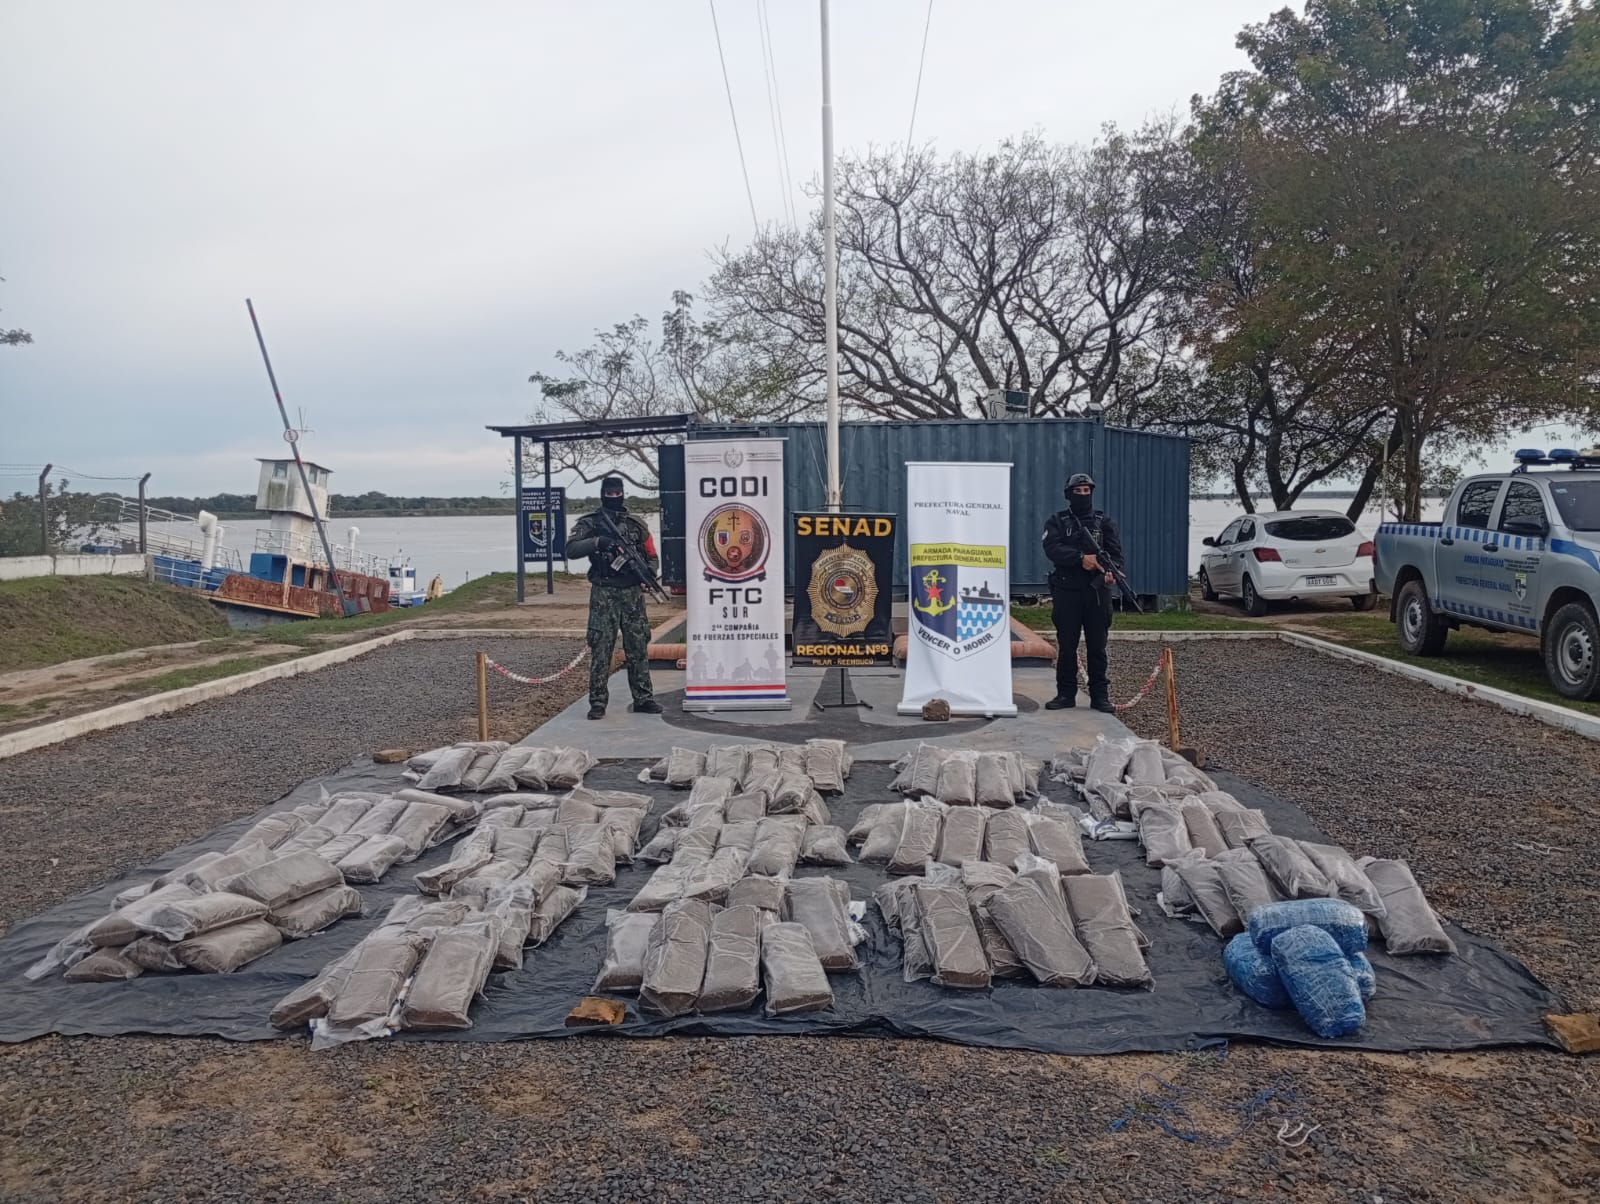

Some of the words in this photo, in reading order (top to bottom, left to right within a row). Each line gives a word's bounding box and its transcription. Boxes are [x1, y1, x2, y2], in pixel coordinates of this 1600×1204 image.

[699, 476, 768, 498] CODI
[965, 502, 1003, 510] GENERAL
[945, 508, 971, 516] NAVAL
[797, 516, 893, 537] SENAD
[923, 547, 952, 555] ARMADA
[953, 547, 993, 556] PARAGUAYA
[912, 555, 953, 563] PREFECTURA
[953, 555, 983, 564] GENERAL
[983, 557, 1004, 565] NAVAL
[708, 587, 762, 606] FTC
[722, 606, 749, 619] SUR
[692, 633, 702, 641] DE
[703, 633, 735, 641] FUERZAS
[737, 632, 779, 641] ESPECIALES
[917, 626, 951, 651] VENCER
[953, 647, 961, 655] O
[963, 632, 994, 653] MORIR
[796, 644, 864, 656] REGIONAL
[812, 658, 833, 666] PILAR
